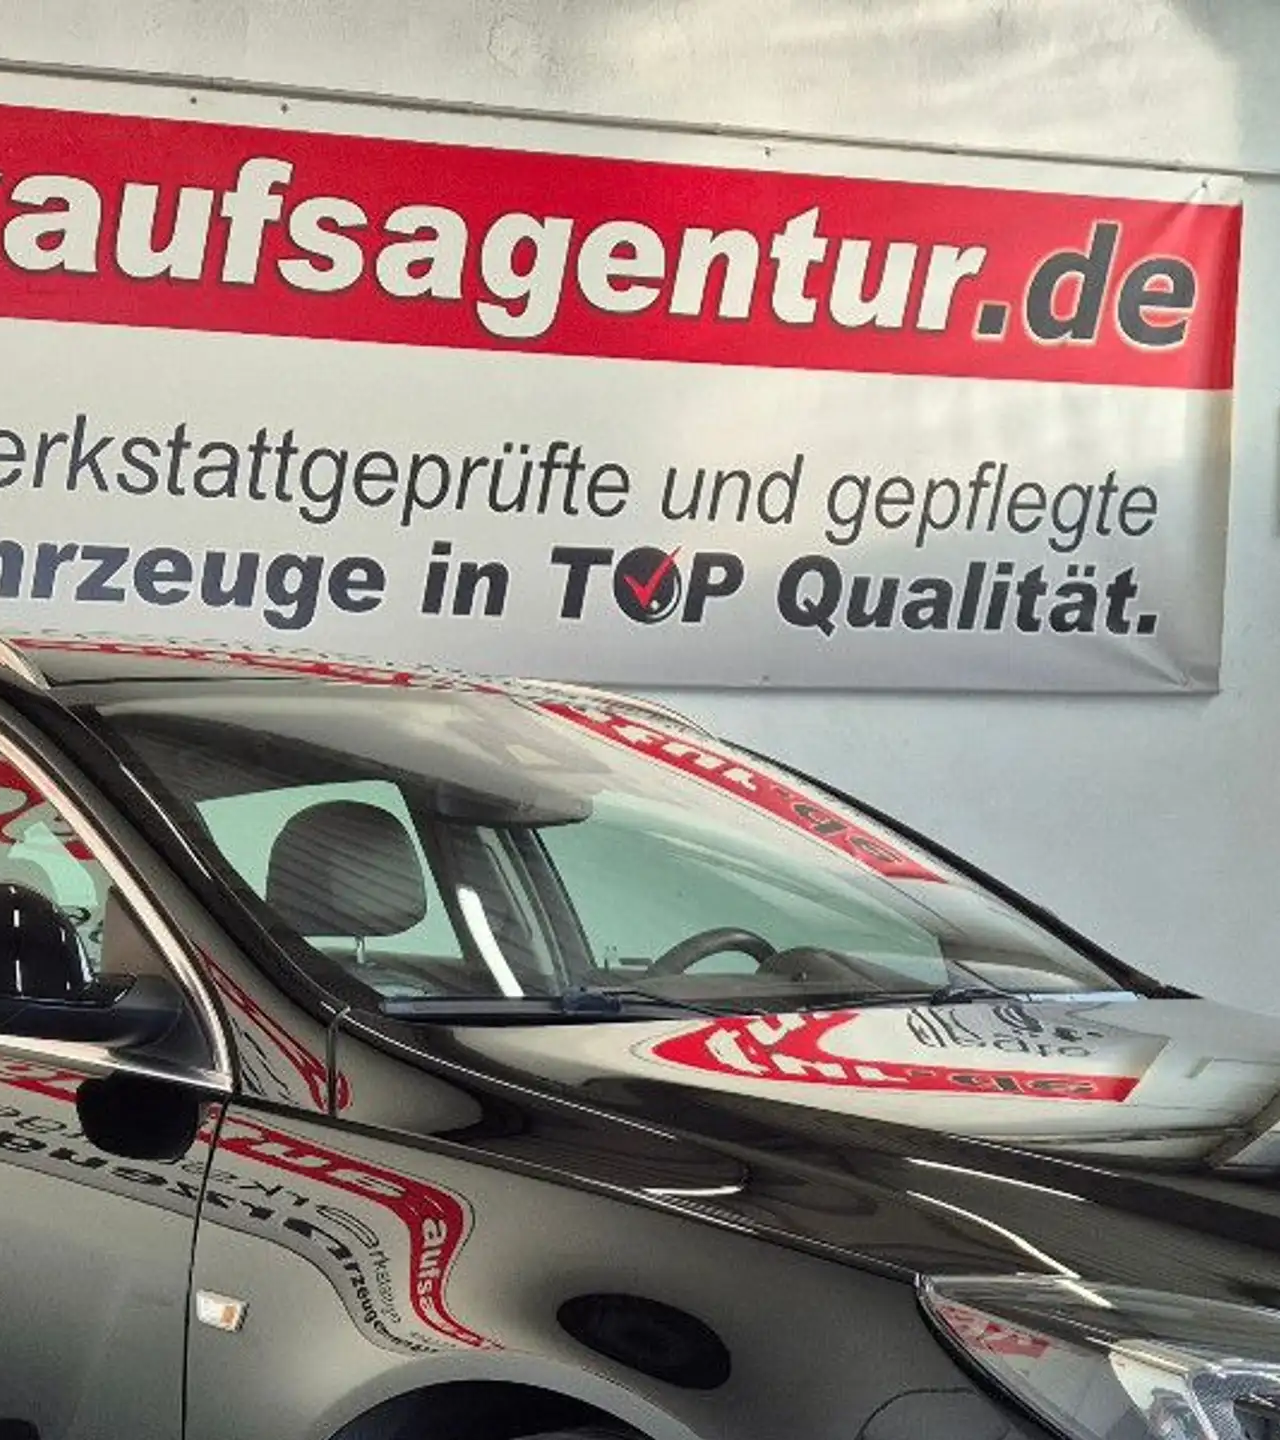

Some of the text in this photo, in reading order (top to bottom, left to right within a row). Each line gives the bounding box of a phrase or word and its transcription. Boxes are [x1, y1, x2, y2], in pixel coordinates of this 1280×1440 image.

[661, 454, 804, 525] und
[826, 462, 1159, 552] gepflegte
[422, 541, 508, 617] in
[550, 545, 745, 625] TOP
[777, 553, 1159, 640] Qualität.
